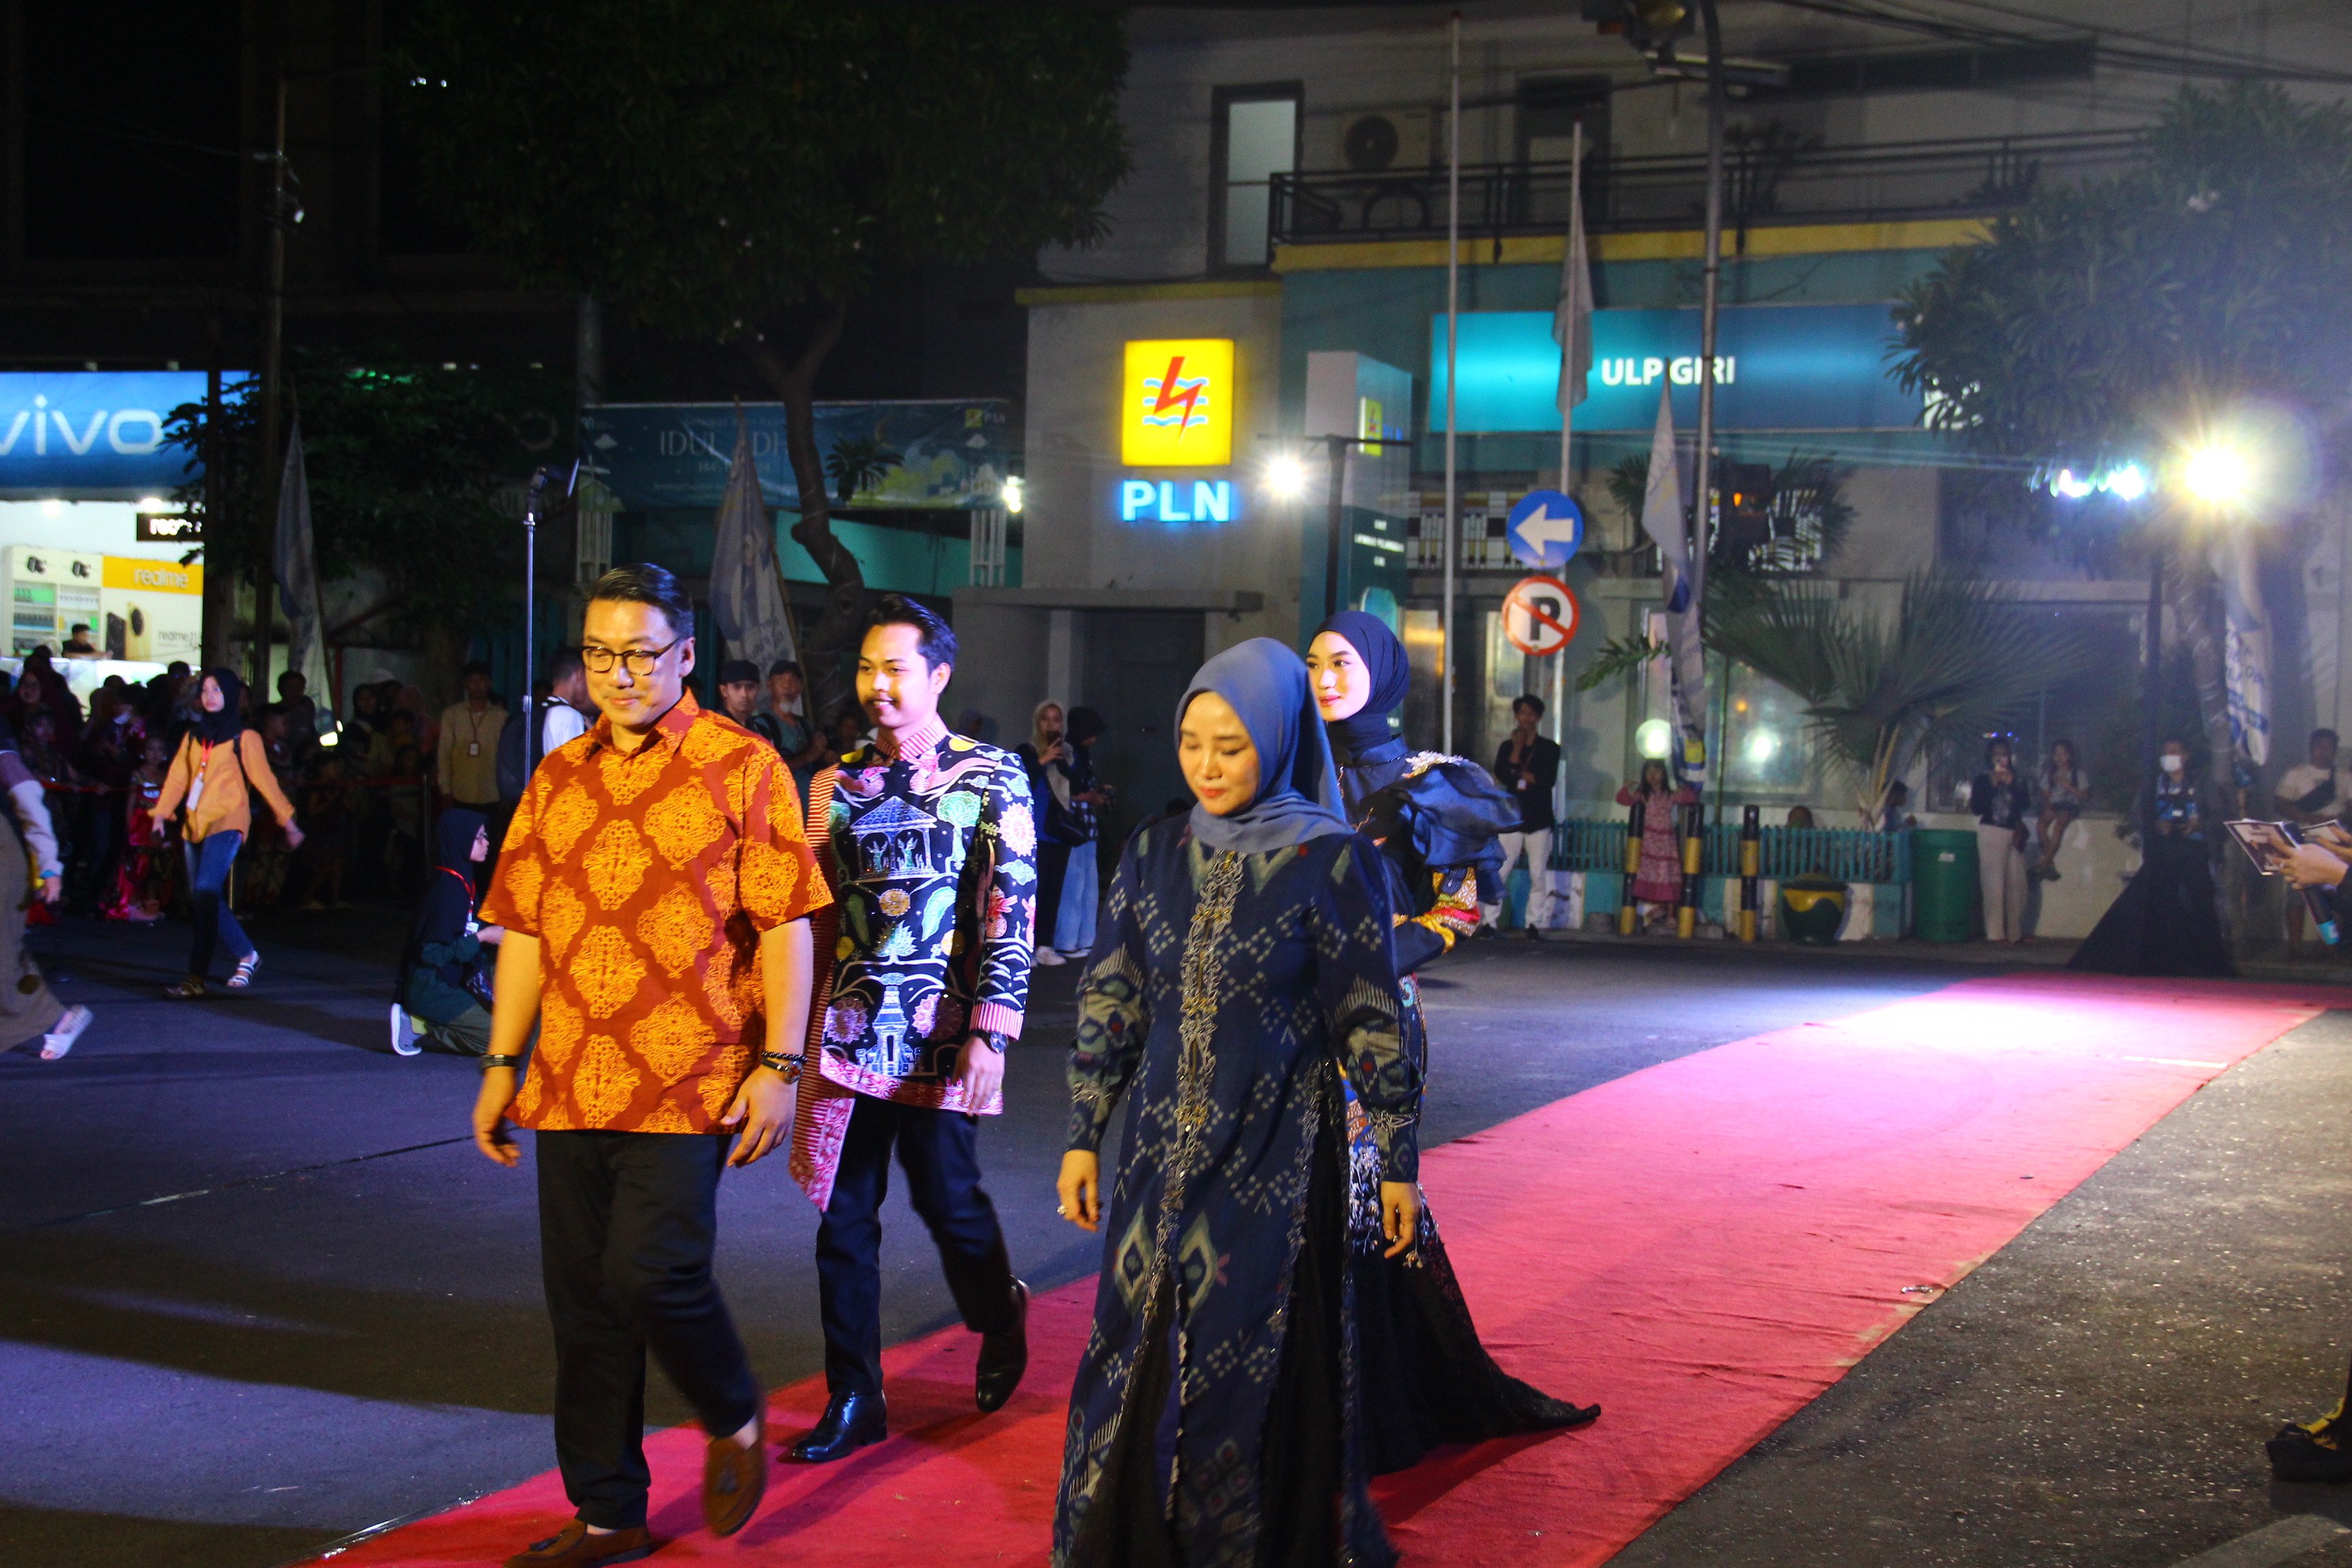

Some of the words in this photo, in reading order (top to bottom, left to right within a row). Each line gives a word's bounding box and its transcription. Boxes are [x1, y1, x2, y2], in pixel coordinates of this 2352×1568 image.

[1601, 357, 1663, 386] ULP
[1669, 355, 1735, 385] GIRI
[1122, 480, 1231, 522] PLN
[134, 568, 189, 588] realme
[159, 630, 189, 642] realme
